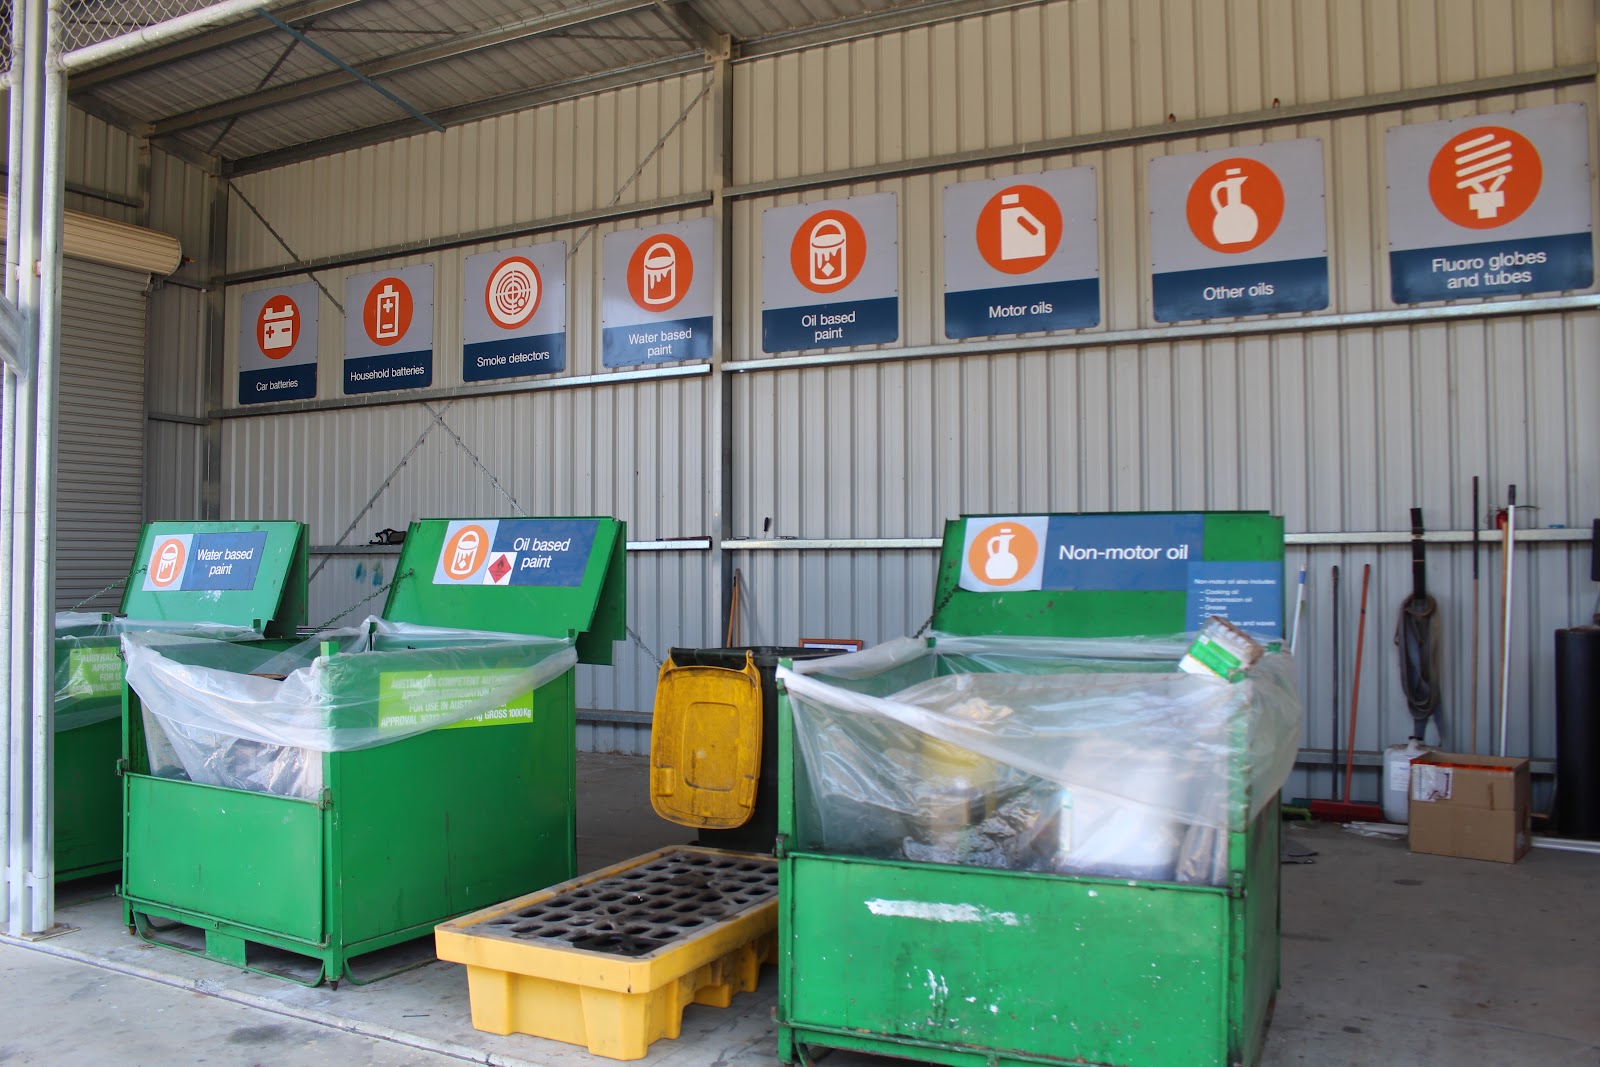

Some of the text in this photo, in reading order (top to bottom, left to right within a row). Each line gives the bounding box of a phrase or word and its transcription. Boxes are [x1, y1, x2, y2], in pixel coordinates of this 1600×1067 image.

[1431, 250, 1547, 273] Fluoro globes
[1446, 268, 1533, 290] and tubes
[1202, 281, 1275, 301] Other oils
[988, 301, 1053, 319] Motor oils
[801, 310, 856, 328] Oil based
[628, 327, 692, 346] Water based
[814, 326, 843, 343] paint
[476, 350, 550, 368] Smoke detectors
[647, 344, 673, 359] paint
[350, 365, 425, 382] Household batteries
[256, 378, 299, 392] Car batteries
[513, 537, 571, 552] Oil based
[1058, 544, 1189, 561] Non-motor oil
[197, 547, 255, 561] Water based
[520, 554, 553, 571] paint
[208, 562, 233, 578] paint
[409, 703, 424, 712] FOR
[425, 702, 440, 712] USE
[440, 701, 449, 710] IN
[381, 714, 418, 727] APPROVAL
[485, 709, 507, 719] GROSS
